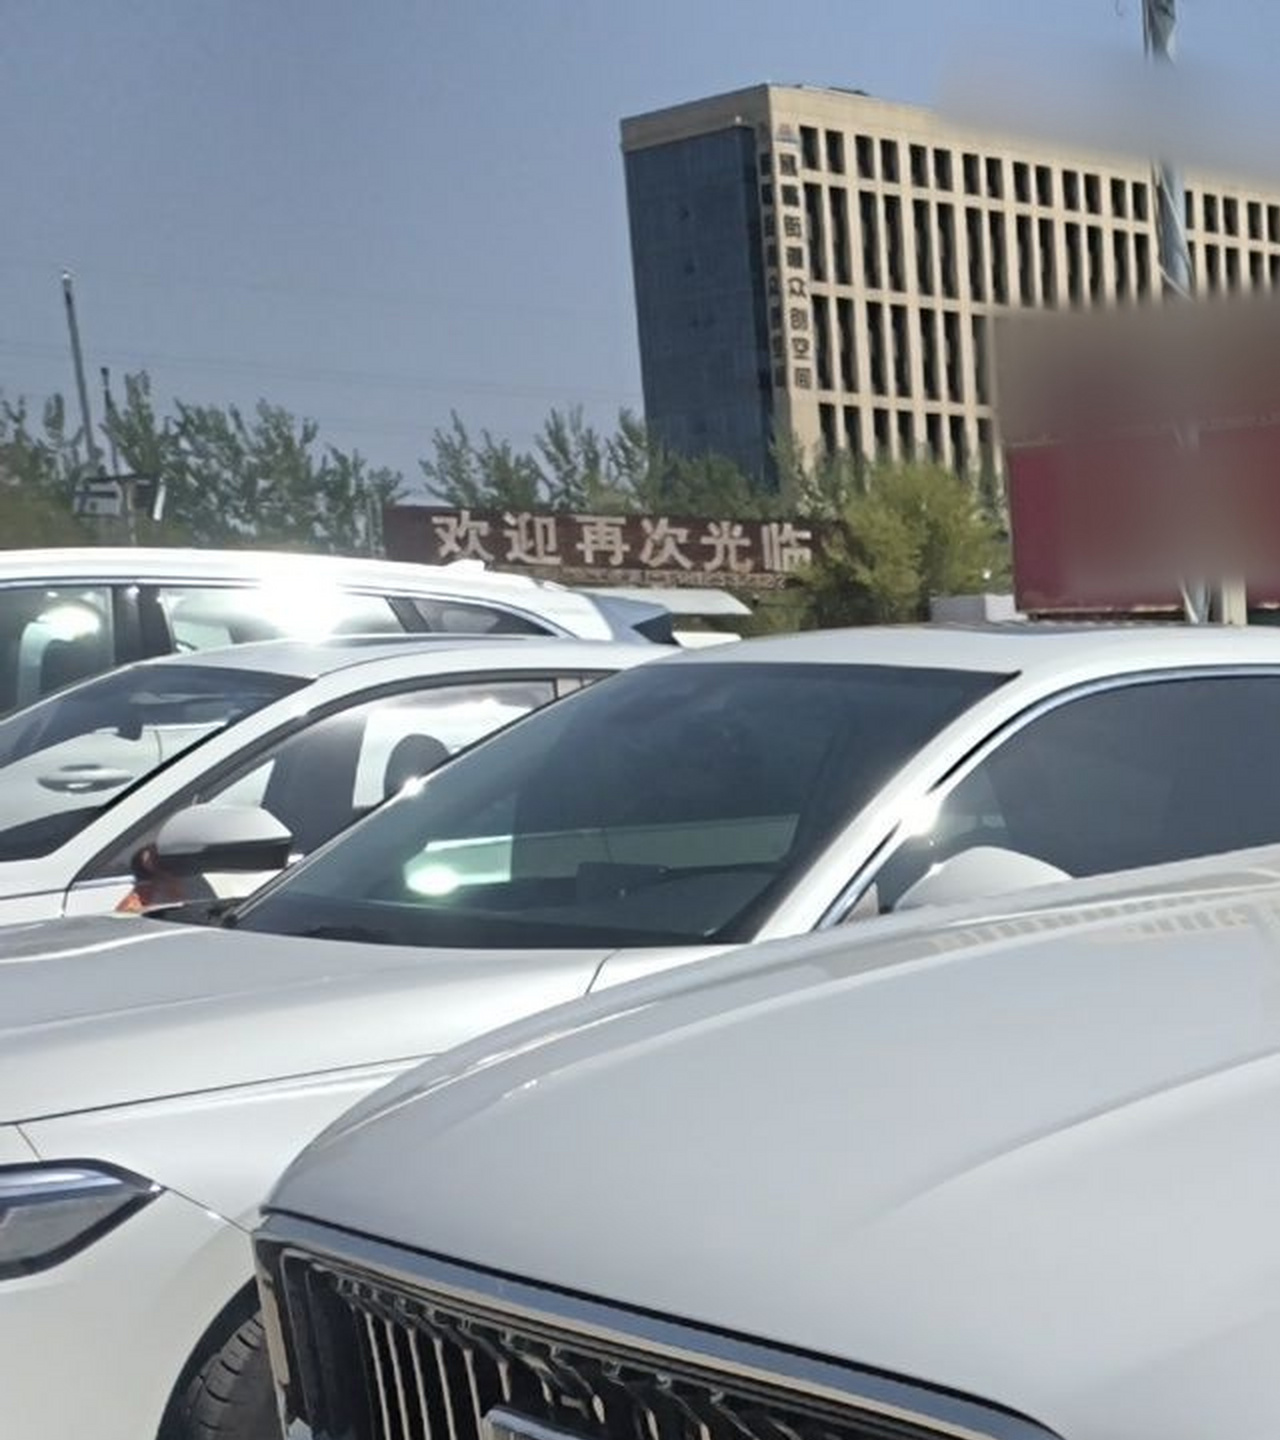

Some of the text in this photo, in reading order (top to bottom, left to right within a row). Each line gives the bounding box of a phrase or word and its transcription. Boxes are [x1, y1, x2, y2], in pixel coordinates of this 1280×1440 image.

[431, 511, 812, 571] 欢迎再次光临
